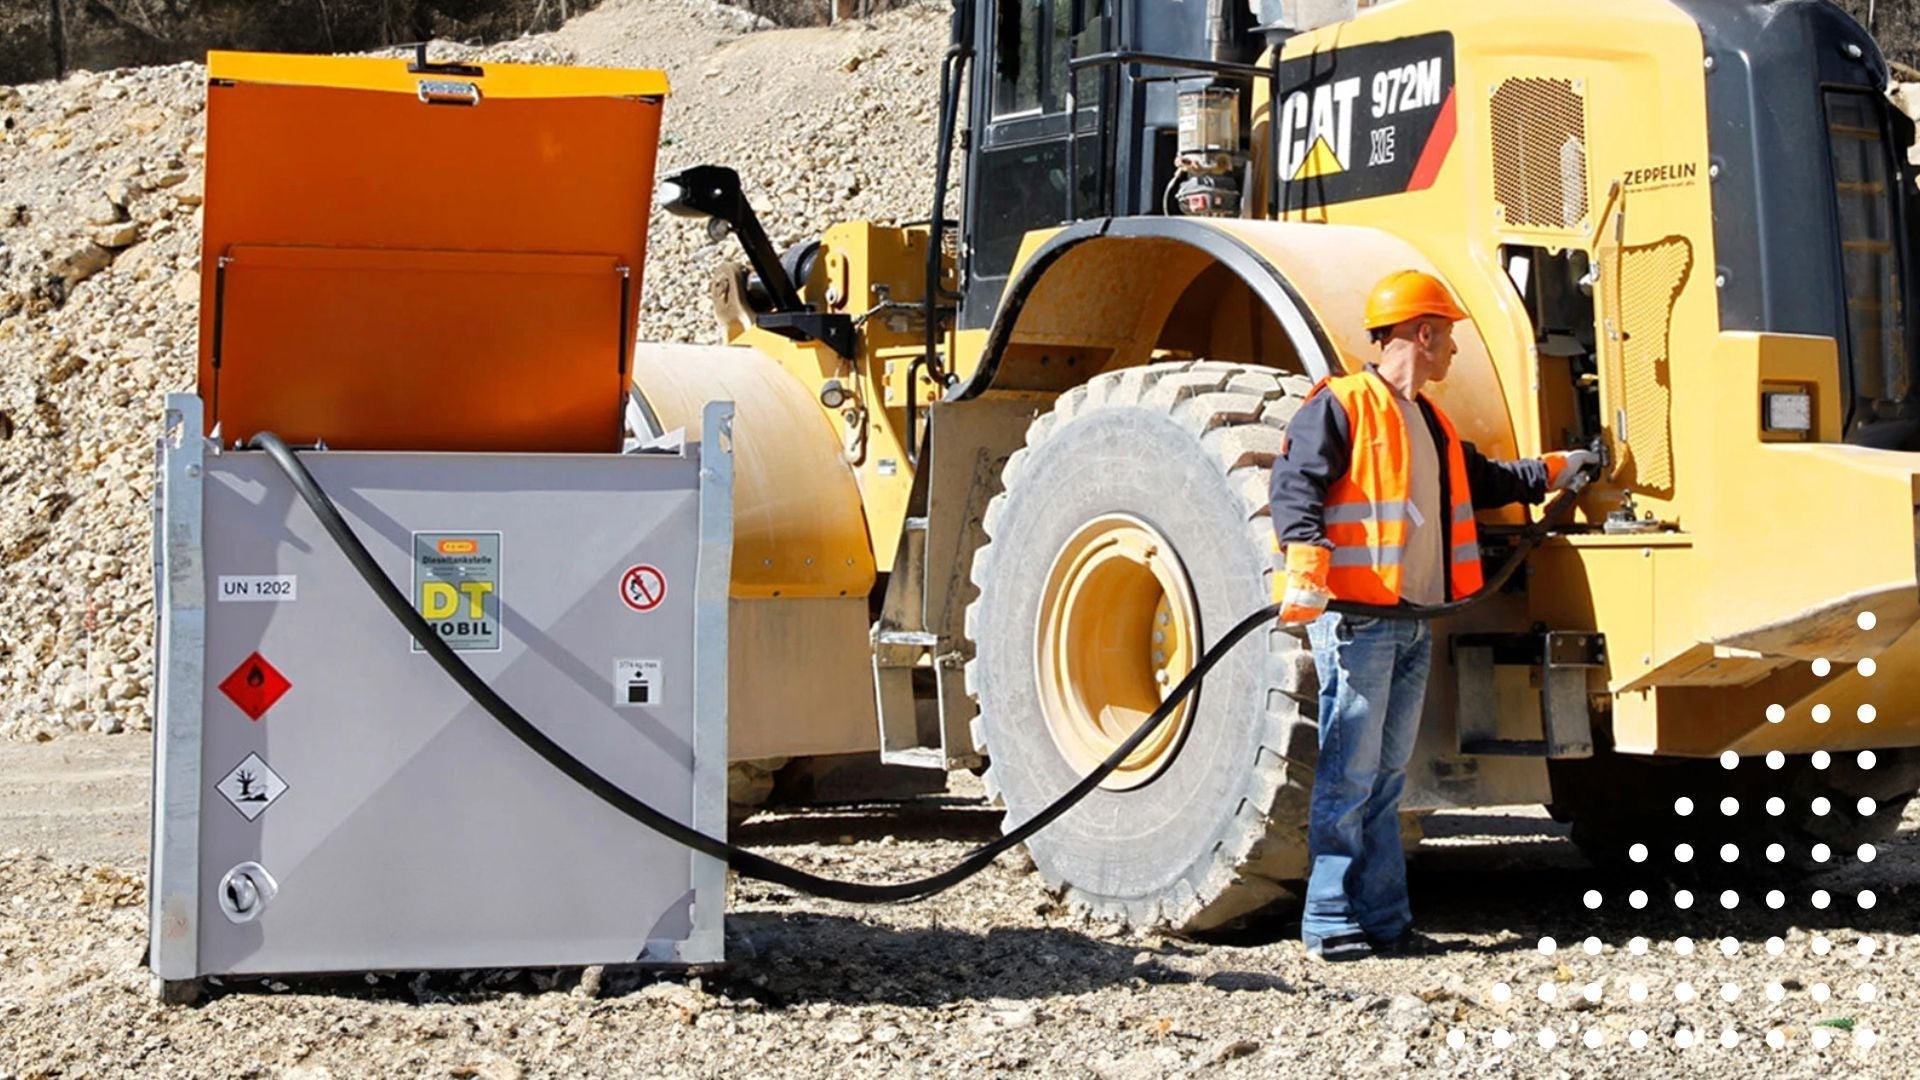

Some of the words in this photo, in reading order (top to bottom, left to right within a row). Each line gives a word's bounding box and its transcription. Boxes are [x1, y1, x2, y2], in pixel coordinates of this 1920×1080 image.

[1278, 77, 1360, 181] CAT
[1371, 57, 1442, 118] 972M
[1368, 126, 1395, 167] XE
[1623, 162, 1696, 186] ZEPPELIN
[224, 581, 248, 595] UN
[255, 581, 291, 595] 1202
[422, 581, 494, 620] DT
